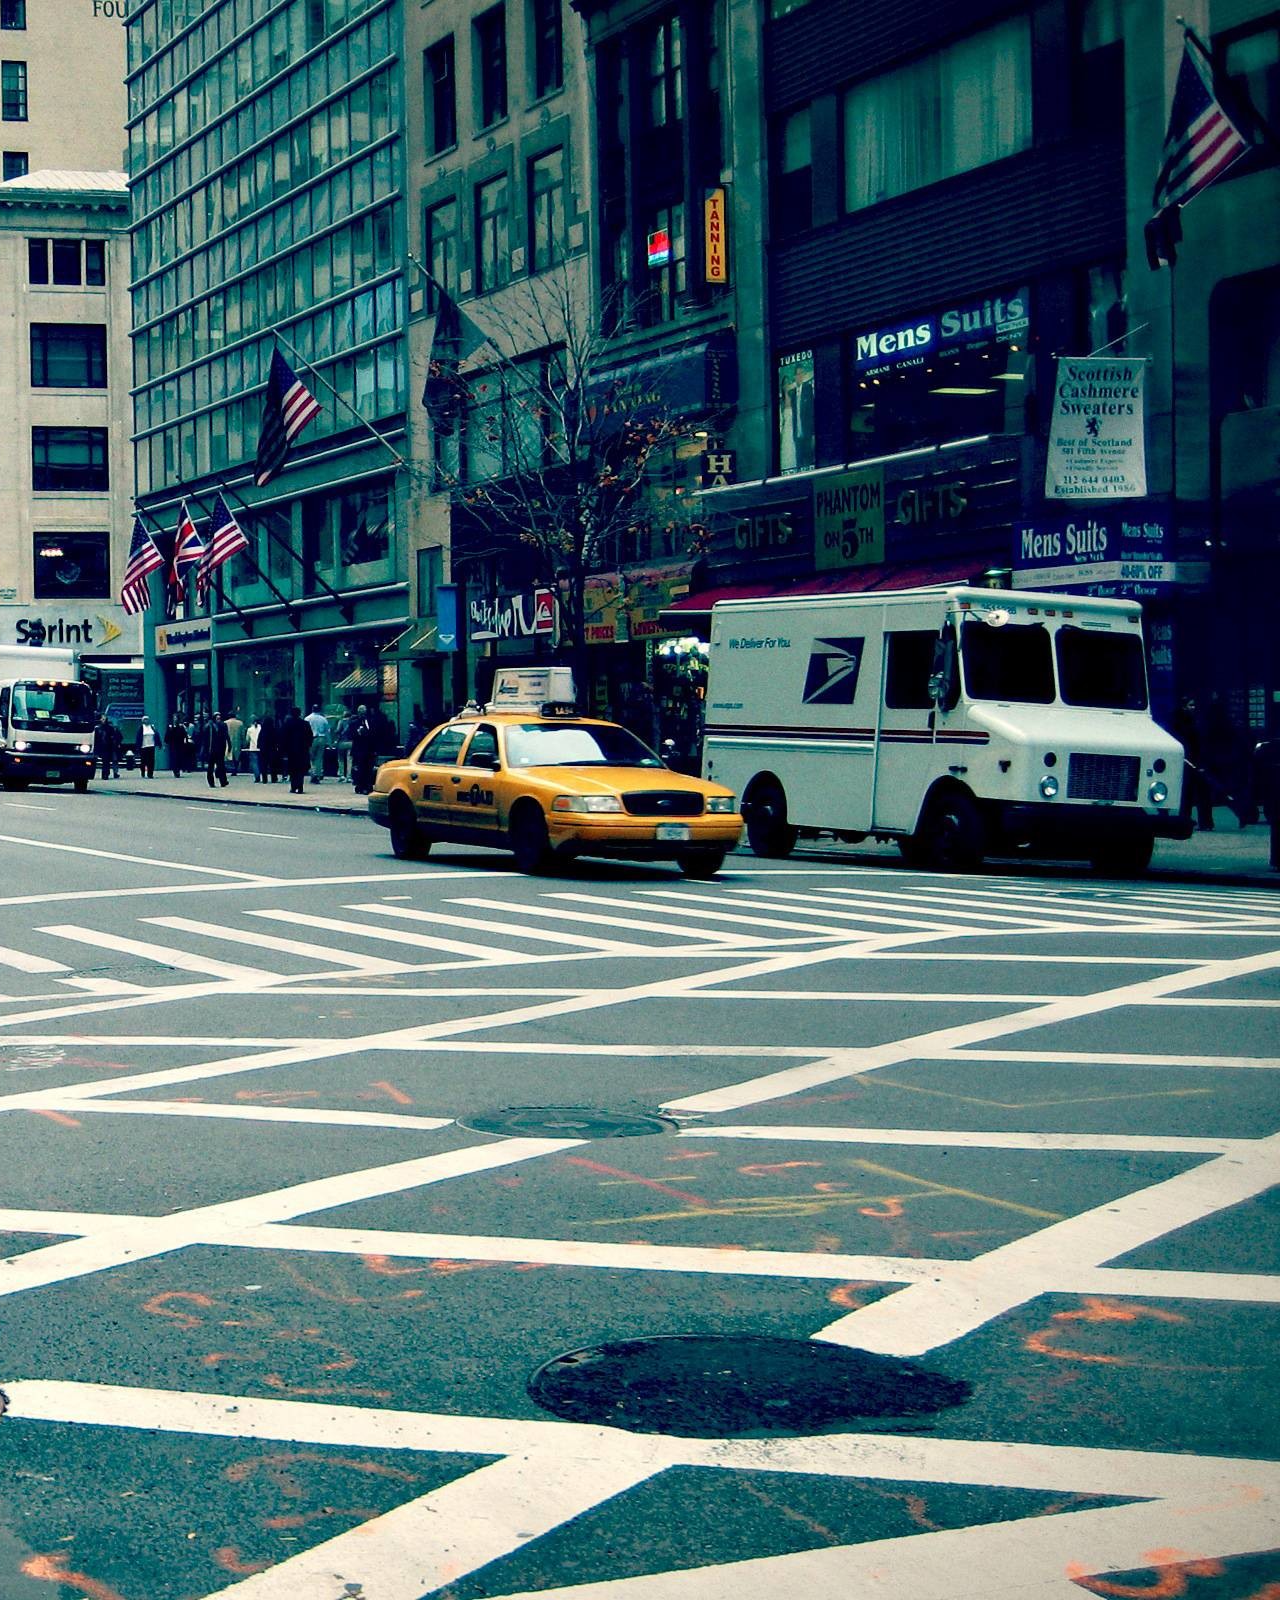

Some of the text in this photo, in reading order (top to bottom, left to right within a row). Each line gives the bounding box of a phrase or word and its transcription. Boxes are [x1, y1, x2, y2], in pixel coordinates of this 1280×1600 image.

[709, 199, 721, 277] TANNING
[856, 297, 1024, 361] Mens Suits
[780, 350, 813, 366] TUXEDO
[896, 357, 925, 370] CANALI
[1067, 365, 1132, 381] Scottish
[1058, 382, 1139, 398] Cashmere
[1060, 400, 1133, 416] Sweaters
[1056, 438, 1132, 447] Best of Scotland
[1055, 485, 1108, 494] Established
[816, 481, 881, 518] PHANTOM
[894, 481, 968, 526] GIFTS
[735, 512, 793, 550] GIFTS
[824, 531, 840, 549] ON
[1021, 520, 1108, 560] Mens Suits
[1148, 565, 1163, 579] OFF
[729, 639, 739, 649] We
[740, 638, 764, 649] Deliver
[765, 637, 776, 648] For
